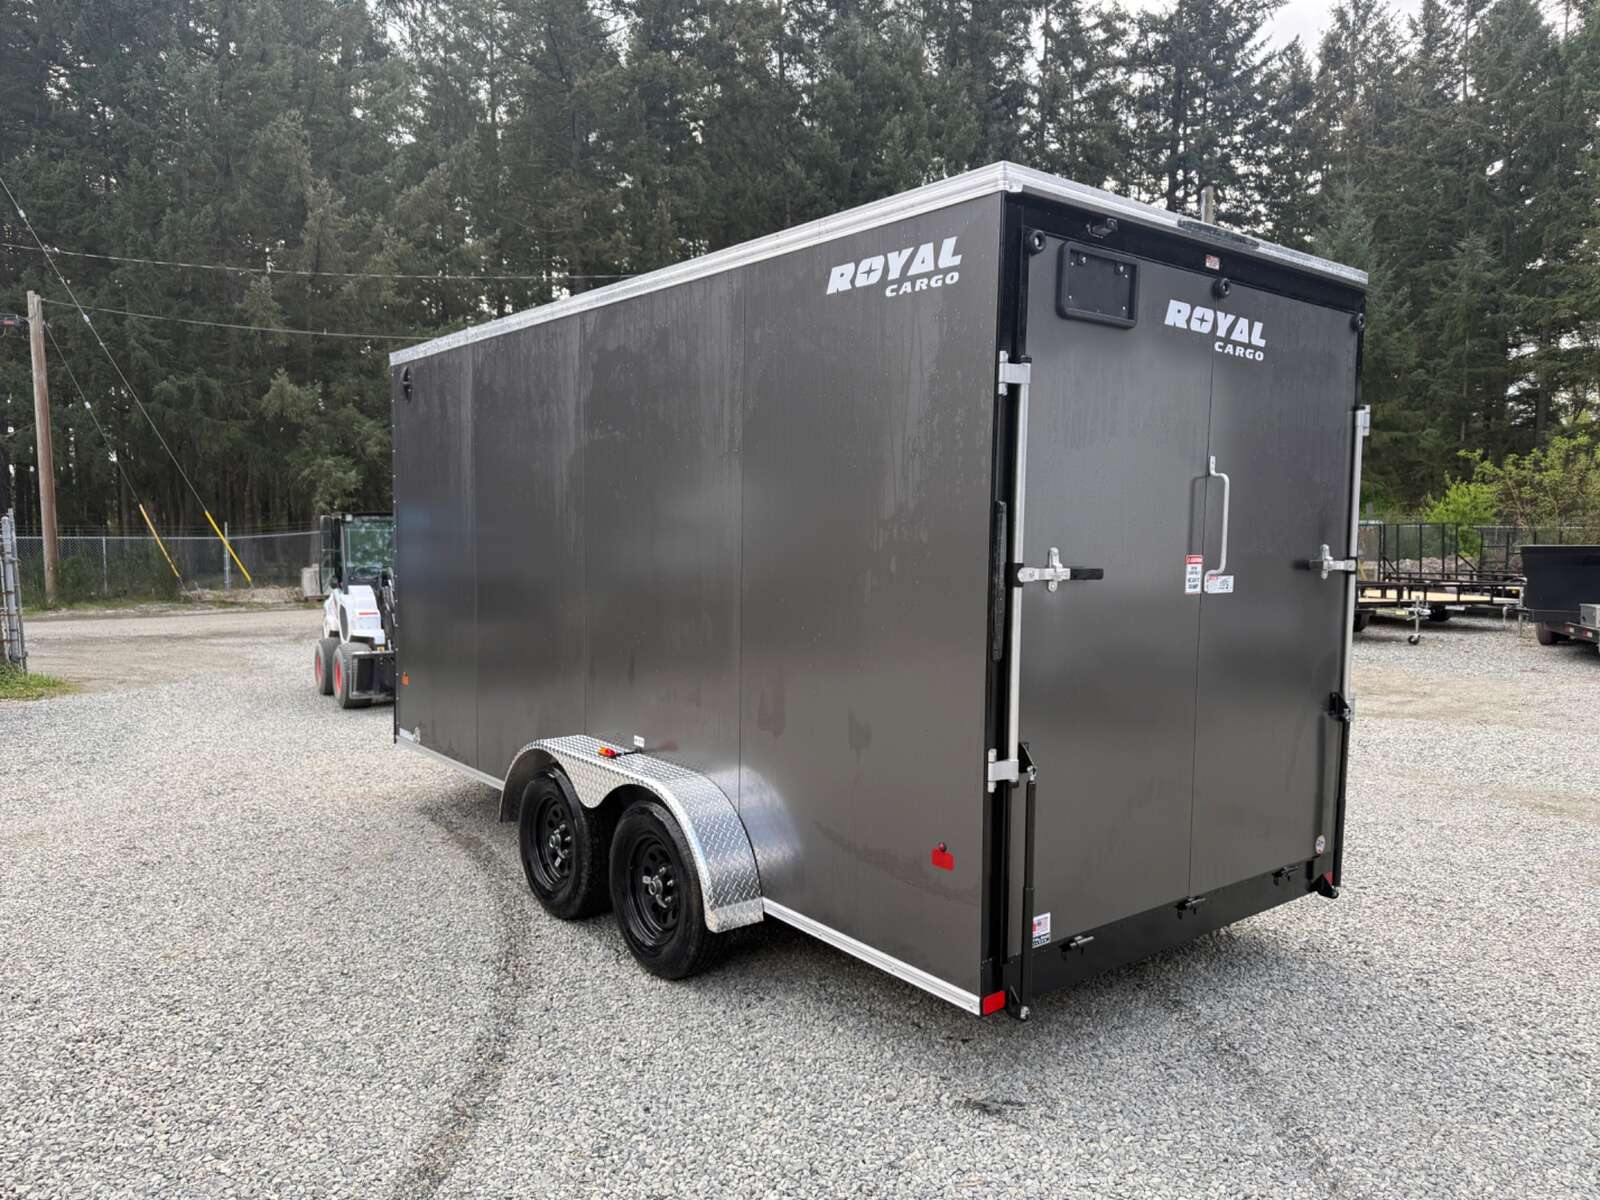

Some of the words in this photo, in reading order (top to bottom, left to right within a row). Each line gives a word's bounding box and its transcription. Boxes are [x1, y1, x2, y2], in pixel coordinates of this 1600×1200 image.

[827, 236, 962, 295] ROYAL
[885, 271, 960, 297] CARGO
[1164, 299, 1266, 347] ROYAL
[1214, 341, 1264, 361] CARGO
